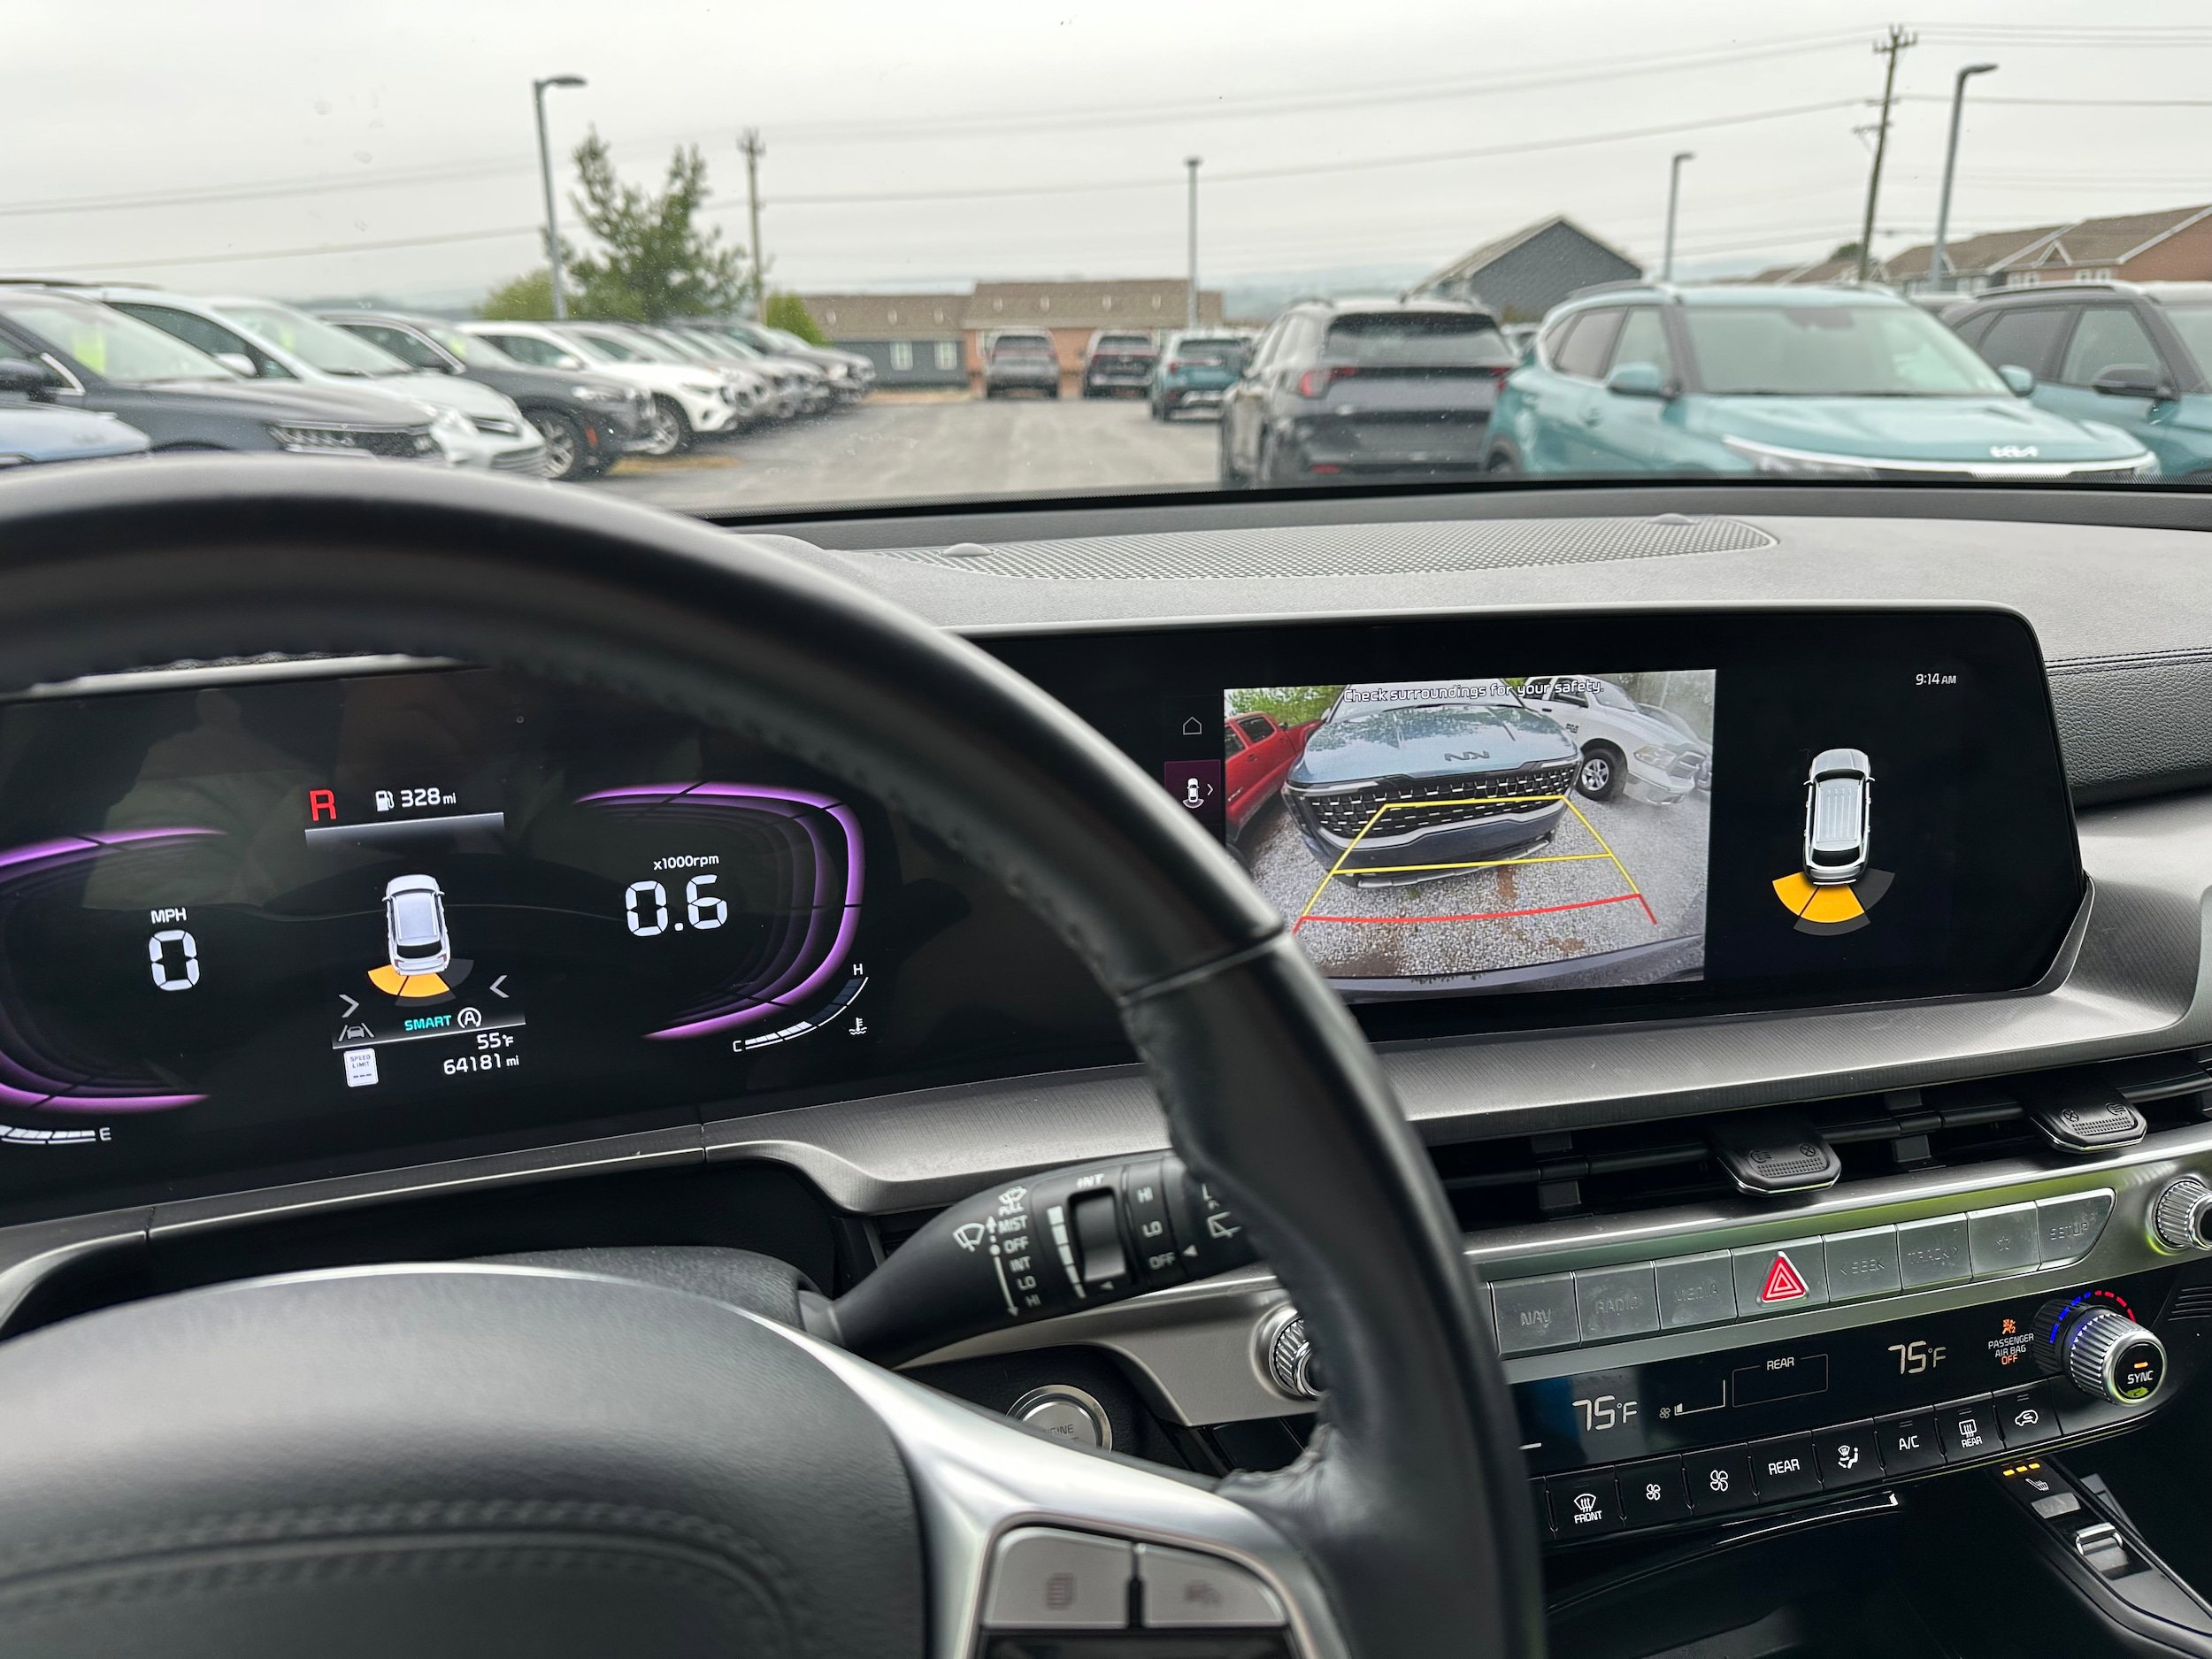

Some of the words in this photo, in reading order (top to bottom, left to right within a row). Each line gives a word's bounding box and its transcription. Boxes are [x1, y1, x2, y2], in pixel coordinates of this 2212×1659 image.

[1916, 672, 1940, 686] 9:14
[1941, 674, 1957, 685] AM
[1344, 688, 1388, 703] Check
[1390, 685, 1486, 700] surroundings
[1490, 683, 1513, 695] for
[1517, 683, 1551, 696] your
[1555, 679, 1604, 694] safety.
[309, 788, 337, 822] R
[400, 787, 441, 808] 328
[442, 792, 457, 805] mi
[653, 855, 720, 871] x1000rpm
[625, 874, 728, 937] 0.6
[150, 907, 188, 925] MPH
[149, 929, 200, 991] 0
[852, 963, 864, 976] H
[404, 1015, 452, 1032] SMART
[476, 1032, 514, 1050] 55°F
[733, 1040, 743, 1053] C
[349, 1054, 371, 1063] SPEED
[443, 1053, 502, 1075] 64181
[506, 1055, 519, 1067] mi
[99, 1126, 112, 1141] E
[1077, 1172, 1105, 1188] INT
[997, 1215, 1028, 1234] MIST
[1141, 1220, 1164, 1238] LO
[1002, 1235, 1029, 1255] OFF
[1009, 1256, 1031, 1273] INT
[1148, 1252, 1175, 1270] OFF
[1017, 1275, 1037, 1291] LO
[1025, 1294, 1042, 1308] HI
[1519, 1309, 1552, 1326] NAV
[1987, 1333, 2035, 1350] PASSENGER
[1887, 1340, 1947, 1375] 75°F
[1994, 1347, 2009, 1358] AIR
[2009, 1344, 2026, 1356] BAG
[1766, 1356, 1795, 1371] REAR
[2001, 1354, 2019, 1366] OFF
[2126, 1370, 2154, 1385] SYNC
[1571, 1394, 1638, 1432] 75°F
[1899, 1434, 1920, 1451] A/C
[1961, 1435, 1983, 1448] REAR
[1768, 1458, 1801, 1476] REAR
[1574, 1509, 1603, 1525] FRONT
